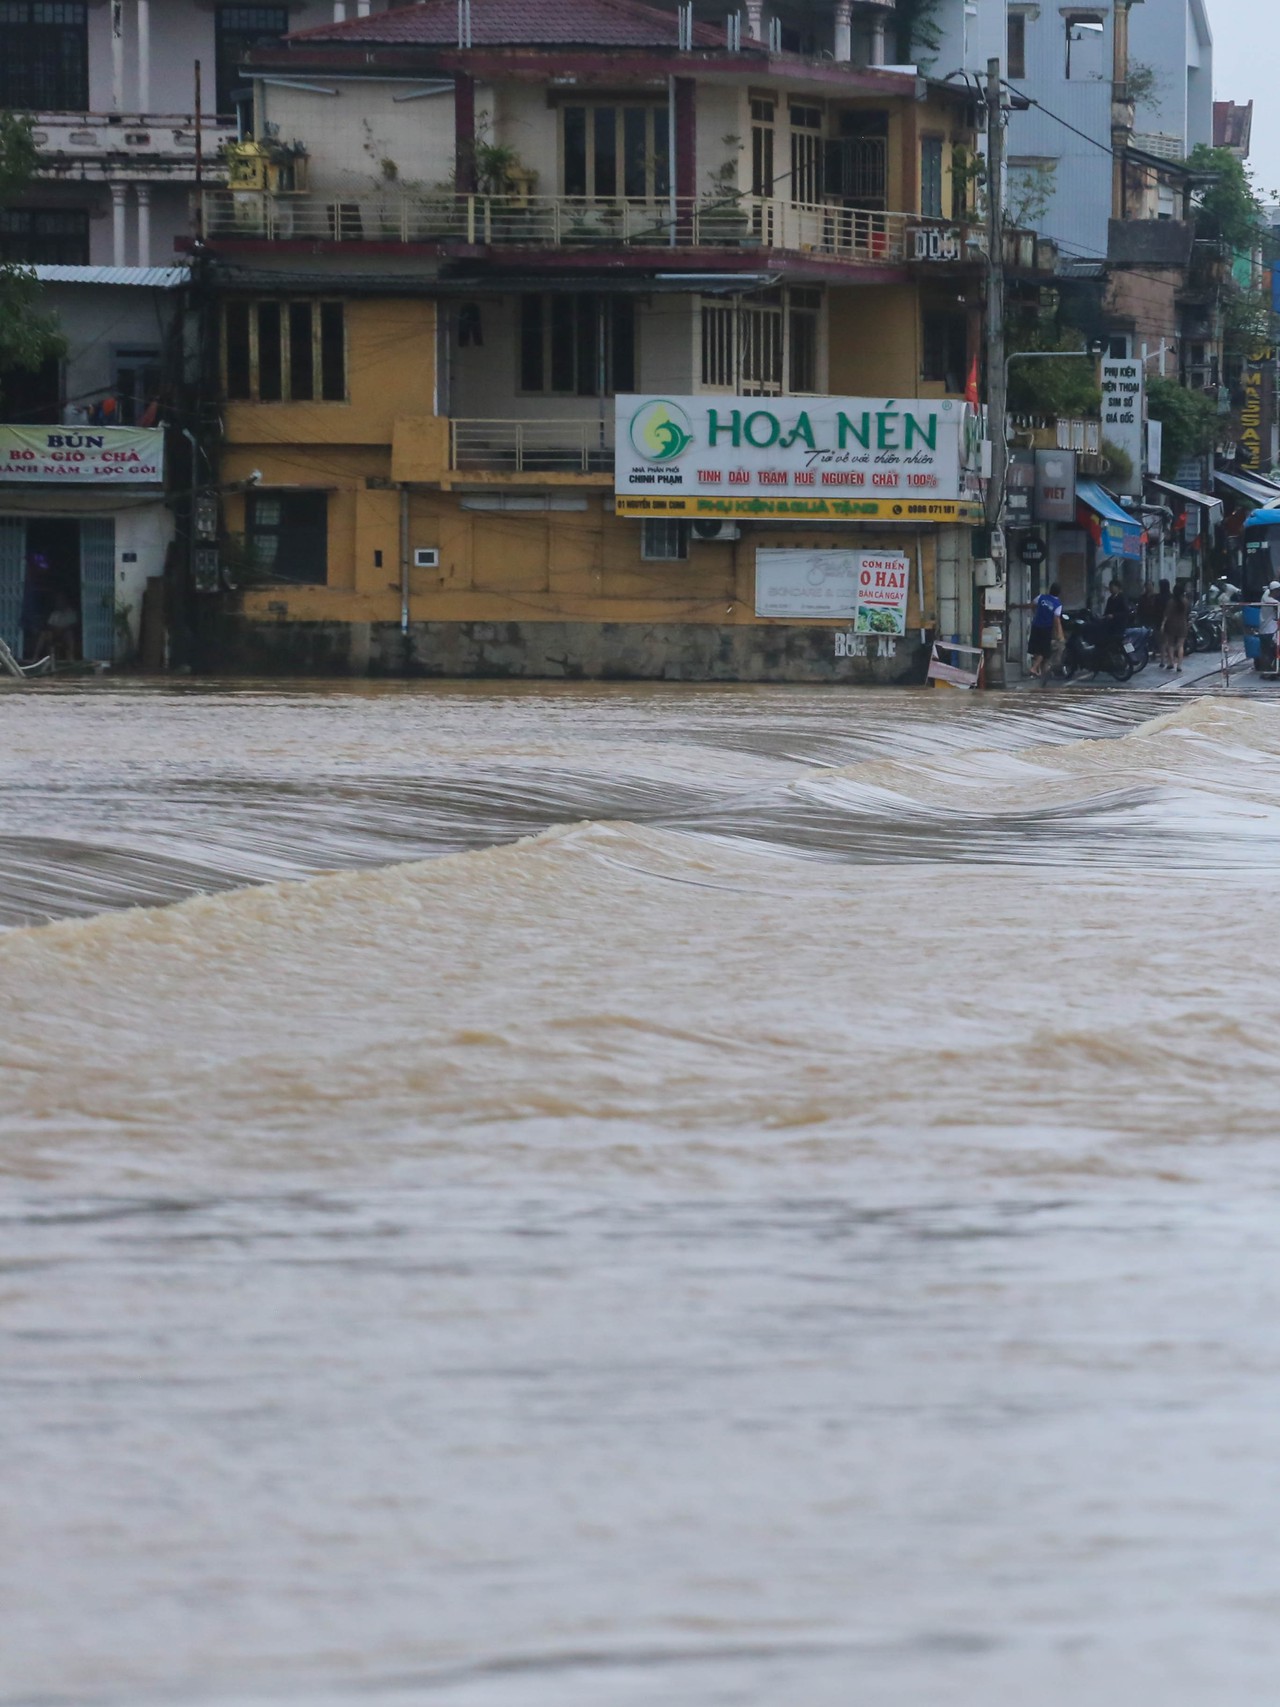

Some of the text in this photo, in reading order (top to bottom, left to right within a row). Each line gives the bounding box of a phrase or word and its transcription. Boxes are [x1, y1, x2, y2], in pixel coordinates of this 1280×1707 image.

[1108, 397, 1121, 407] SIM
[706, 400, 937, 450] HOA NÉN
[47, 431, 105, 448] BÚN
[0, 464, 38, 473] ÁNH
[657, 475, 682, 485] PHẠM
[697, 470, 721, 483] TINH
[822, 469, 864, 486] NGUYÊN
[907, 474, 938, 487] 100%
[875, 571, 906, 588] HAI
